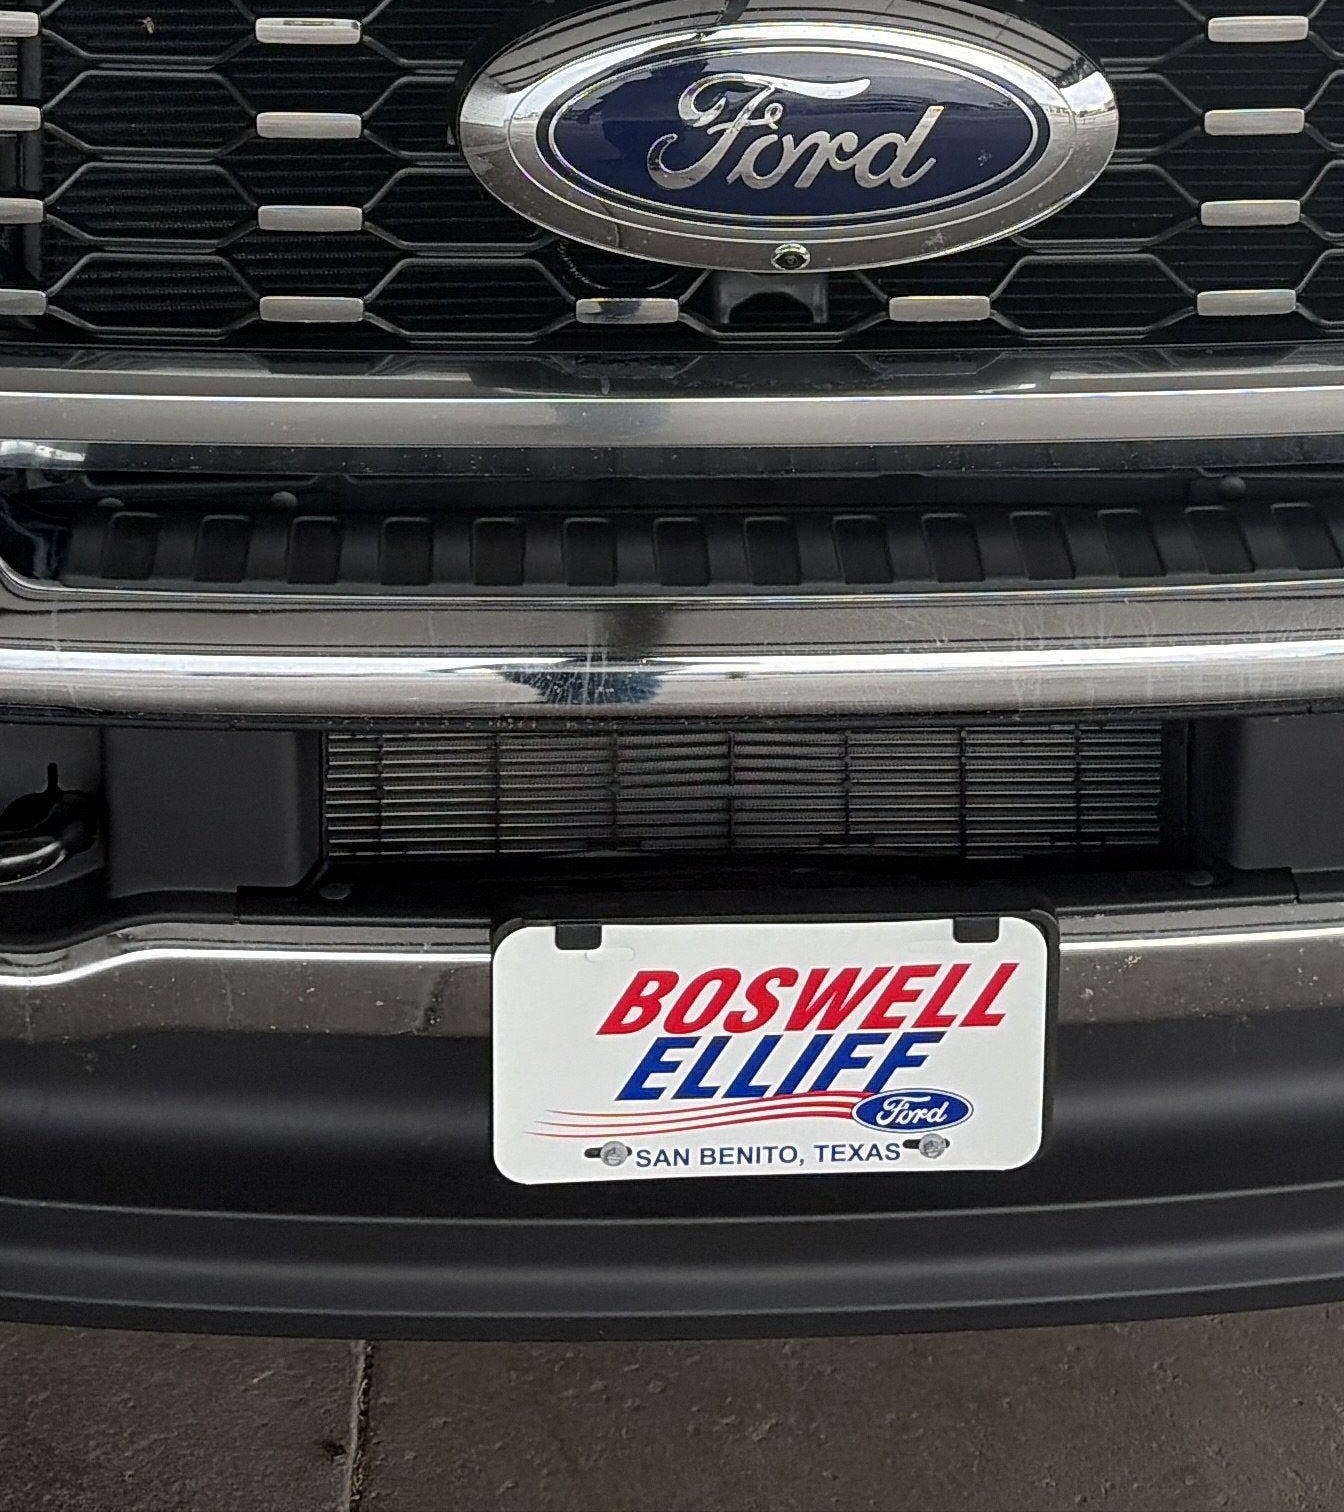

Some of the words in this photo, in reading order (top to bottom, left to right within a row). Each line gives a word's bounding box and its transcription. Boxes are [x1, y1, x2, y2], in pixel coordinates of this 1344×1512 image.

[647, 72, 944, 190] Ford
[596, 962, 1020, 1036] BOSWELL
[614, 1031, 948, 1101] ELLIFF
[875, 1095, 949, 1126] Ford
[635, 1149, 692, 1169] SAN
[699, 1144, 806, 1168] BENITO,
[814, 1142, 901, 1163] TEXAS
